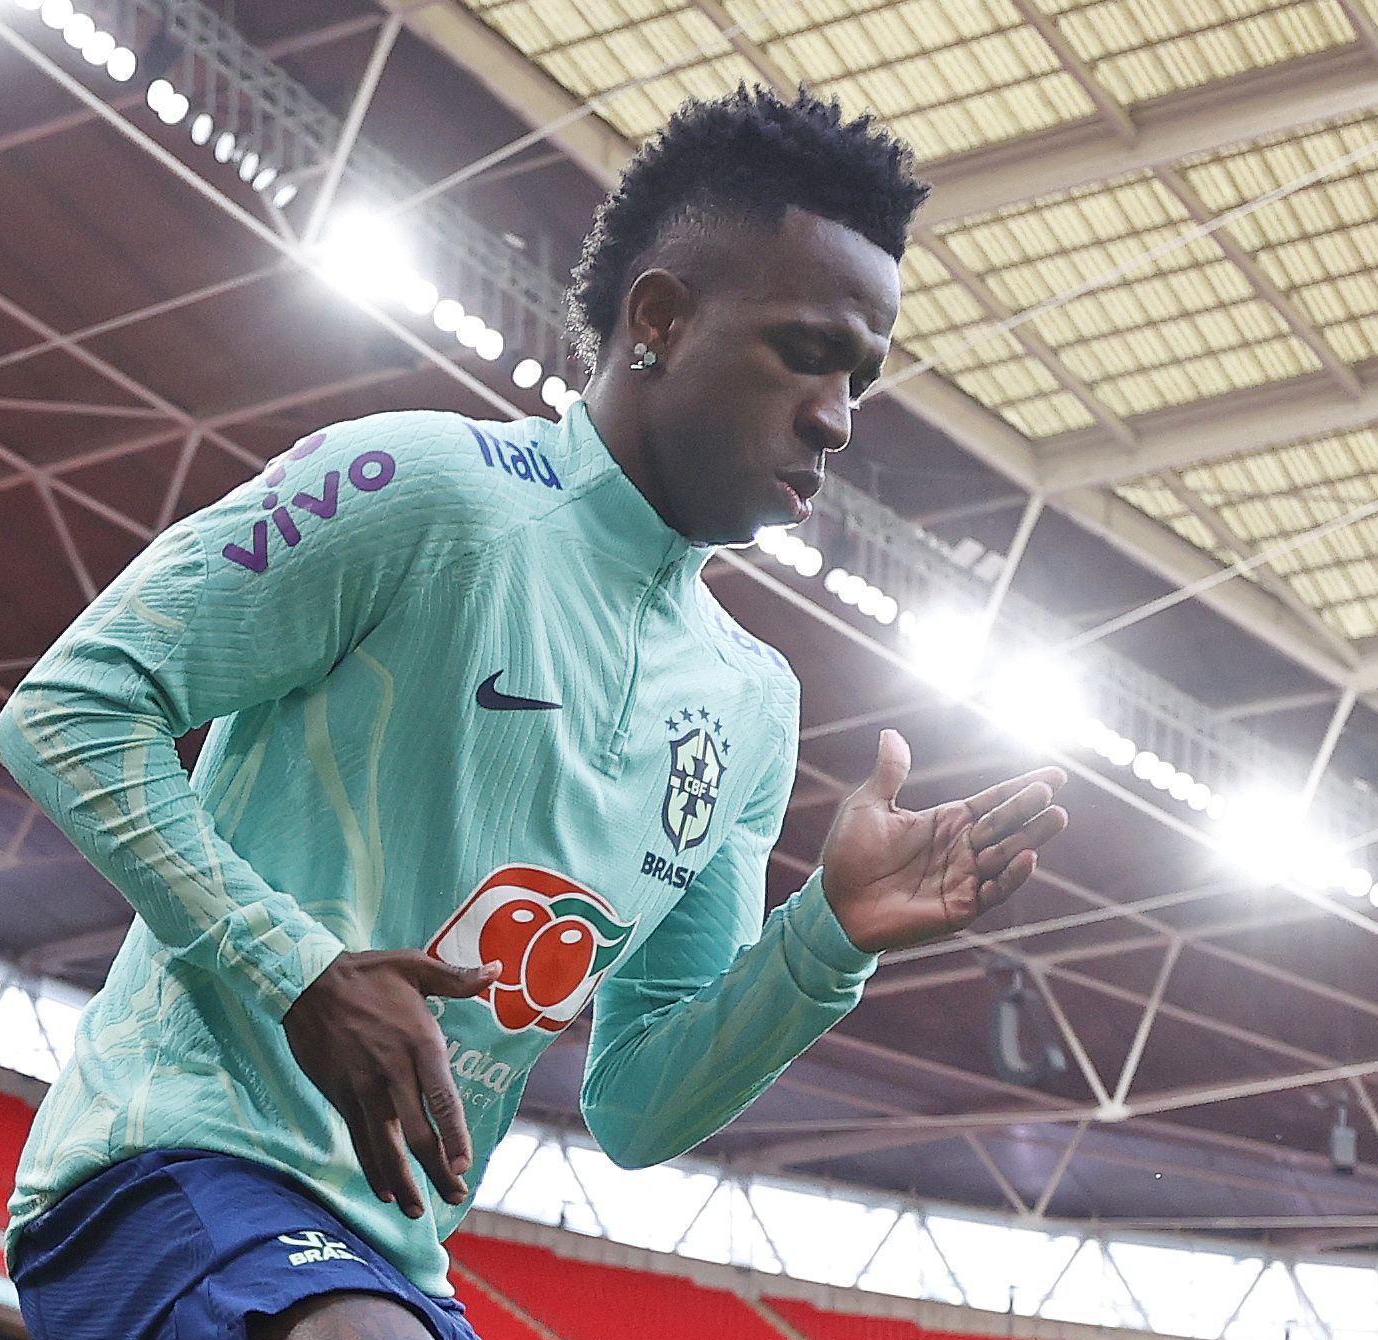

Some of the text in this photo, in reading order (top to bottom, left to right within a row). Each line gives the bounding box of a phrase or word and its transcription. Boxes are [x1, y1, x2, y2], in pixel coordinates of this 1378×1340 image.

[221, 450, 396, 574] vivo
[684, 775, 708, 797] CBF
[640, 851, 696, 891] BRASI
